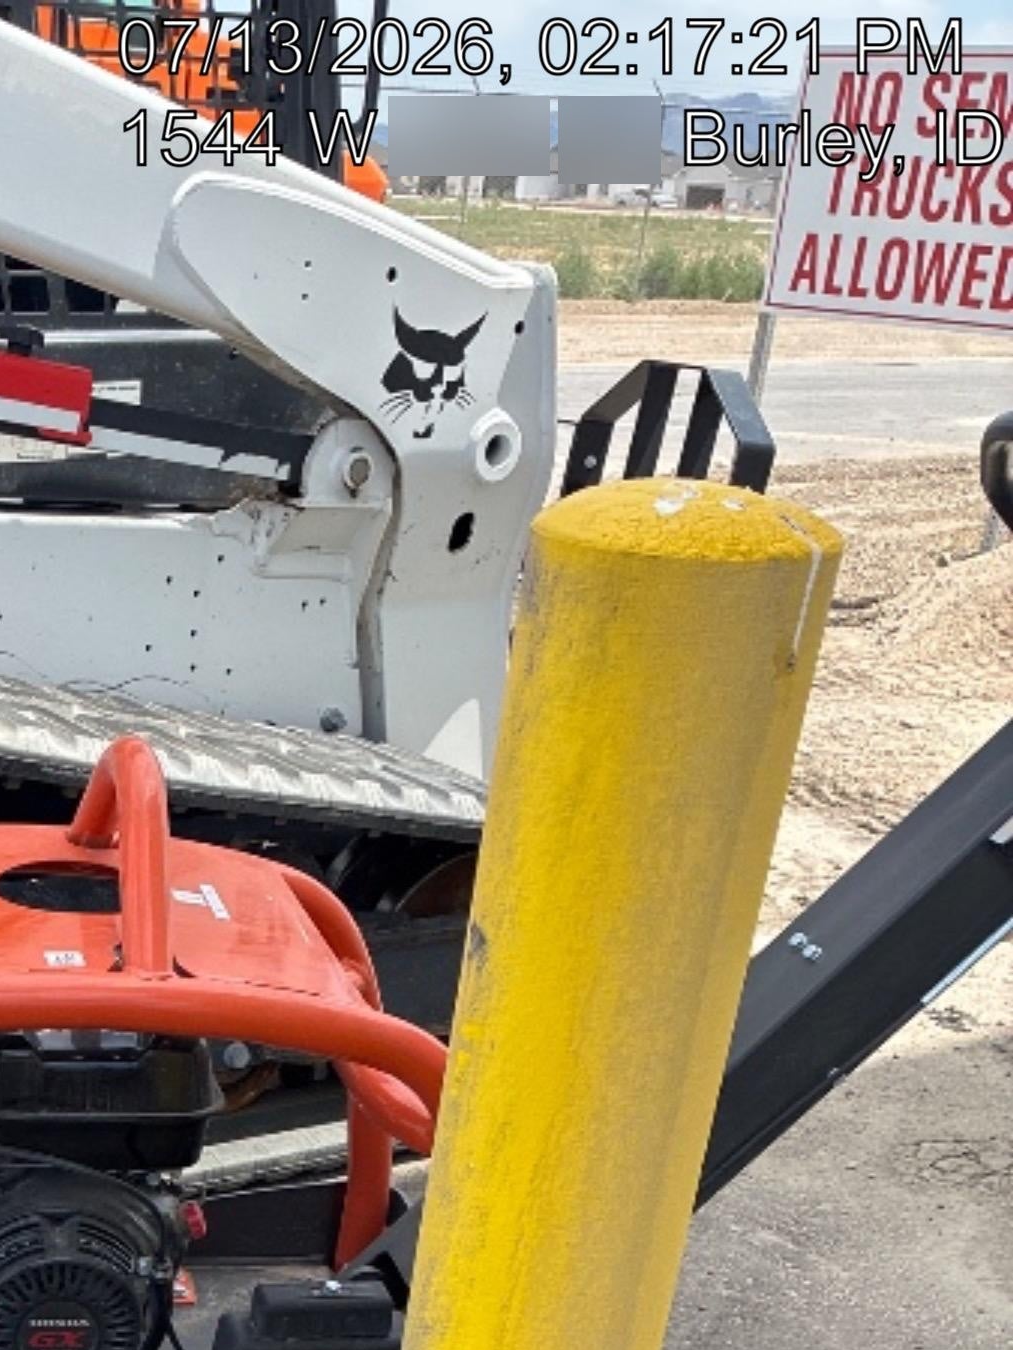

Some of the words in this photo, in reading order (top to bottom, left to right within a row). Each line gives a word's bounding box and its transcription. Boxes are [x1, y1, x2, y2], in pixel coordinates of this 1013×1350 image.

[831, 71, 904, 138] NO
[828, 152, 1013, 226] TRUCKS
[29, 1331, 87, 1348] GX
